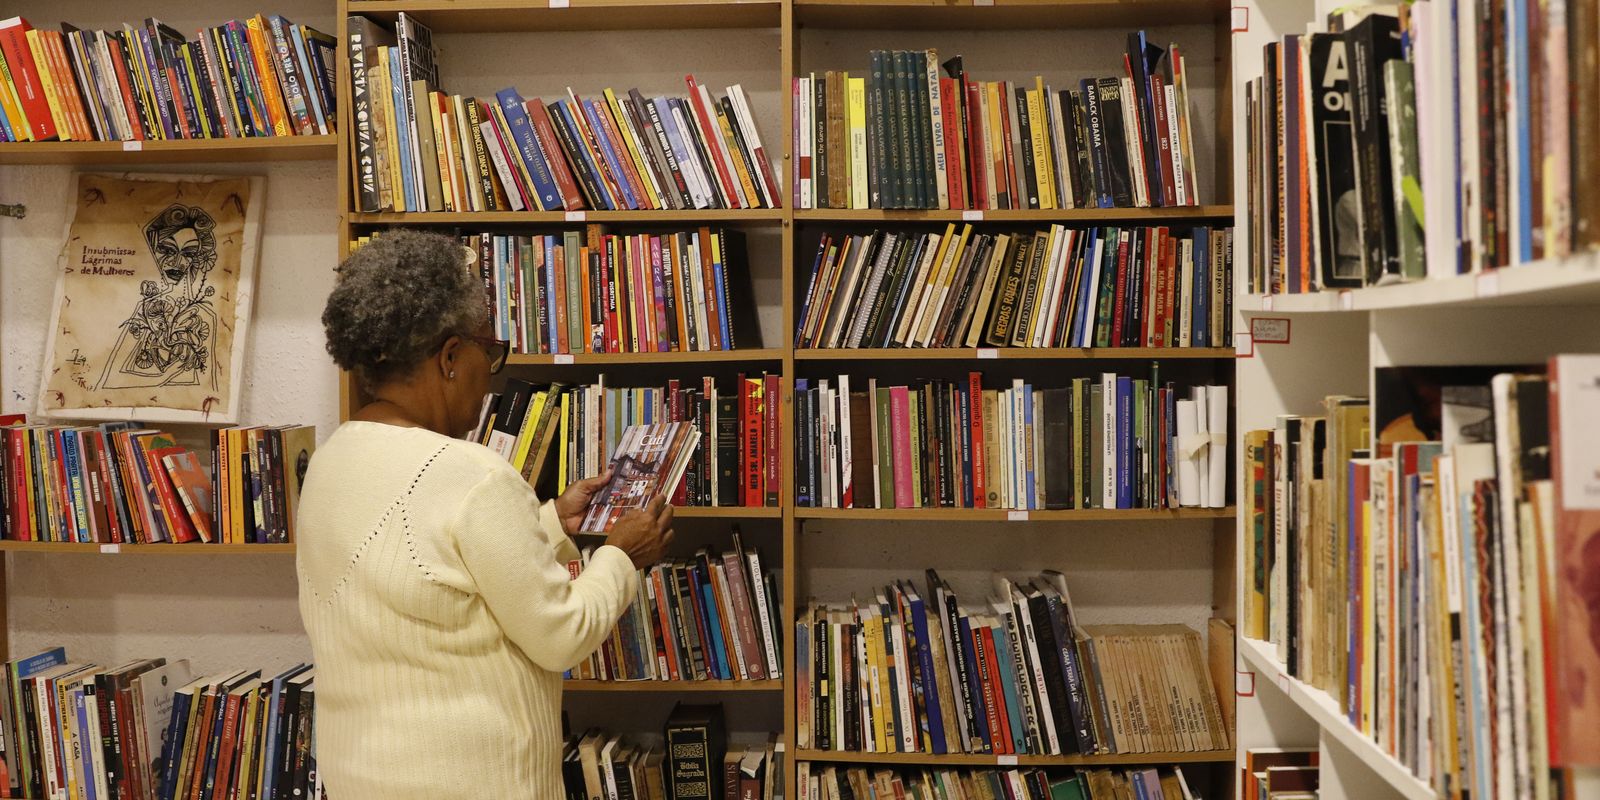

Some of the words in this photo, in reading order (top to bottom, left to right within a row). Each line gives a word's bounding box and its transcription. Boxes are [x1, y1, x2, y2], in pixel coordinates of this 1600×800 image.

[279, 45, 293, 73] PRETO
[351, 33, 365, 97] REVISTA
[286, 74, 301, 99] BOLO
[929, 70, 938, 99] NATAL
[156, 90, 168, 117] CONVERSAS
[645, 102, 655, 114] MAS
[1086, 84, 1097, 115] BARACK
[650, 113, 659, 122] EM
[932, 106, 939, 115] DE
[356, 100, 370, 152] SOUZA
[653, 121, 663, 133] QUE
[933, 121, 942, 146] LIVRO
[1090, 116, 1101, 147] OBAMA
[472, 125, 483, 152] BRANCOS
[657, 131, 670, 150] MUNDO
[1034, 132, 1043, 157] Malala
[1160, 137, 1168, 150] 1822
[664, 149, 672, 157] TU
[936, 153, 944, 171] MEU
[667, 156, 678, 171] VIVE?
[360, 155, 374, 193] CRUZ
[1039, 174, 1046, 184] Eu
[1279, 196, 1284, 213] DO
[83, 246, 136, 256] Insubmissas
[926, 239, 937, 257] LOPES
[946, 239, 957, 257] LOPES
[1016, 243, 1027, 261] HALEY
[1033, 237, 1046, 257] Wright
[82, 255, 122, 265] Lágrimas
[662, 248, 671, 276] AFROTOPIA
[1013, 260, 1023, 274] ALEX
[1028, 256, 1042, 280] Richard
[81, 267, 91, 275] de
[93, 267, 135, 276] Mulheres
[1001, 275, 1020, 305] RAÍZES
[1022, 282, 1036, 308] NATIVO
[1116, 277, 1125, 314] MORRISON
[993, 304, 1013, 337] NEGRAS
[1017, 307, 1031, 333] FILHO
[971, 378, 980, 419] quilombismo
[640, 433, 666, 447] Cuti
[750, 428, 758, 457] AMARELO
[750, 460, 758, 471] SOL
[67, 435, 75, 455] MARIO
[74, 489, 86, 528] BRASILEIROS
[750, 473, 758, 489] MEIO
[751, 560, 761, 583] VIOLA
[756, 584, 765, 607] DAVIS
[760, 611, 766, 619] EM
[762, 621, 770, 640] BUSCA
[951, 612, 960, 641] BRASILEIRA
[766, 643, 772, 651] DE
[956, 642, 965, 671] NEGRITUDE
[1061, 647, 1070, 665] CEARÁ
[961, 672, 966, 681] NA
[1008, 631, 1035, 726] DESPERTAR
[1065, 666, 1074, 682] TERRA
[1069, 682, 1076, 691] DA
[59, 699, 67, 714] LUTHER
[984, 681, 995, 719] SEGREGAÇÃO
[1071, 691, 1079, 703] LUZ
[677, 770, 704, 779] Sagrada
